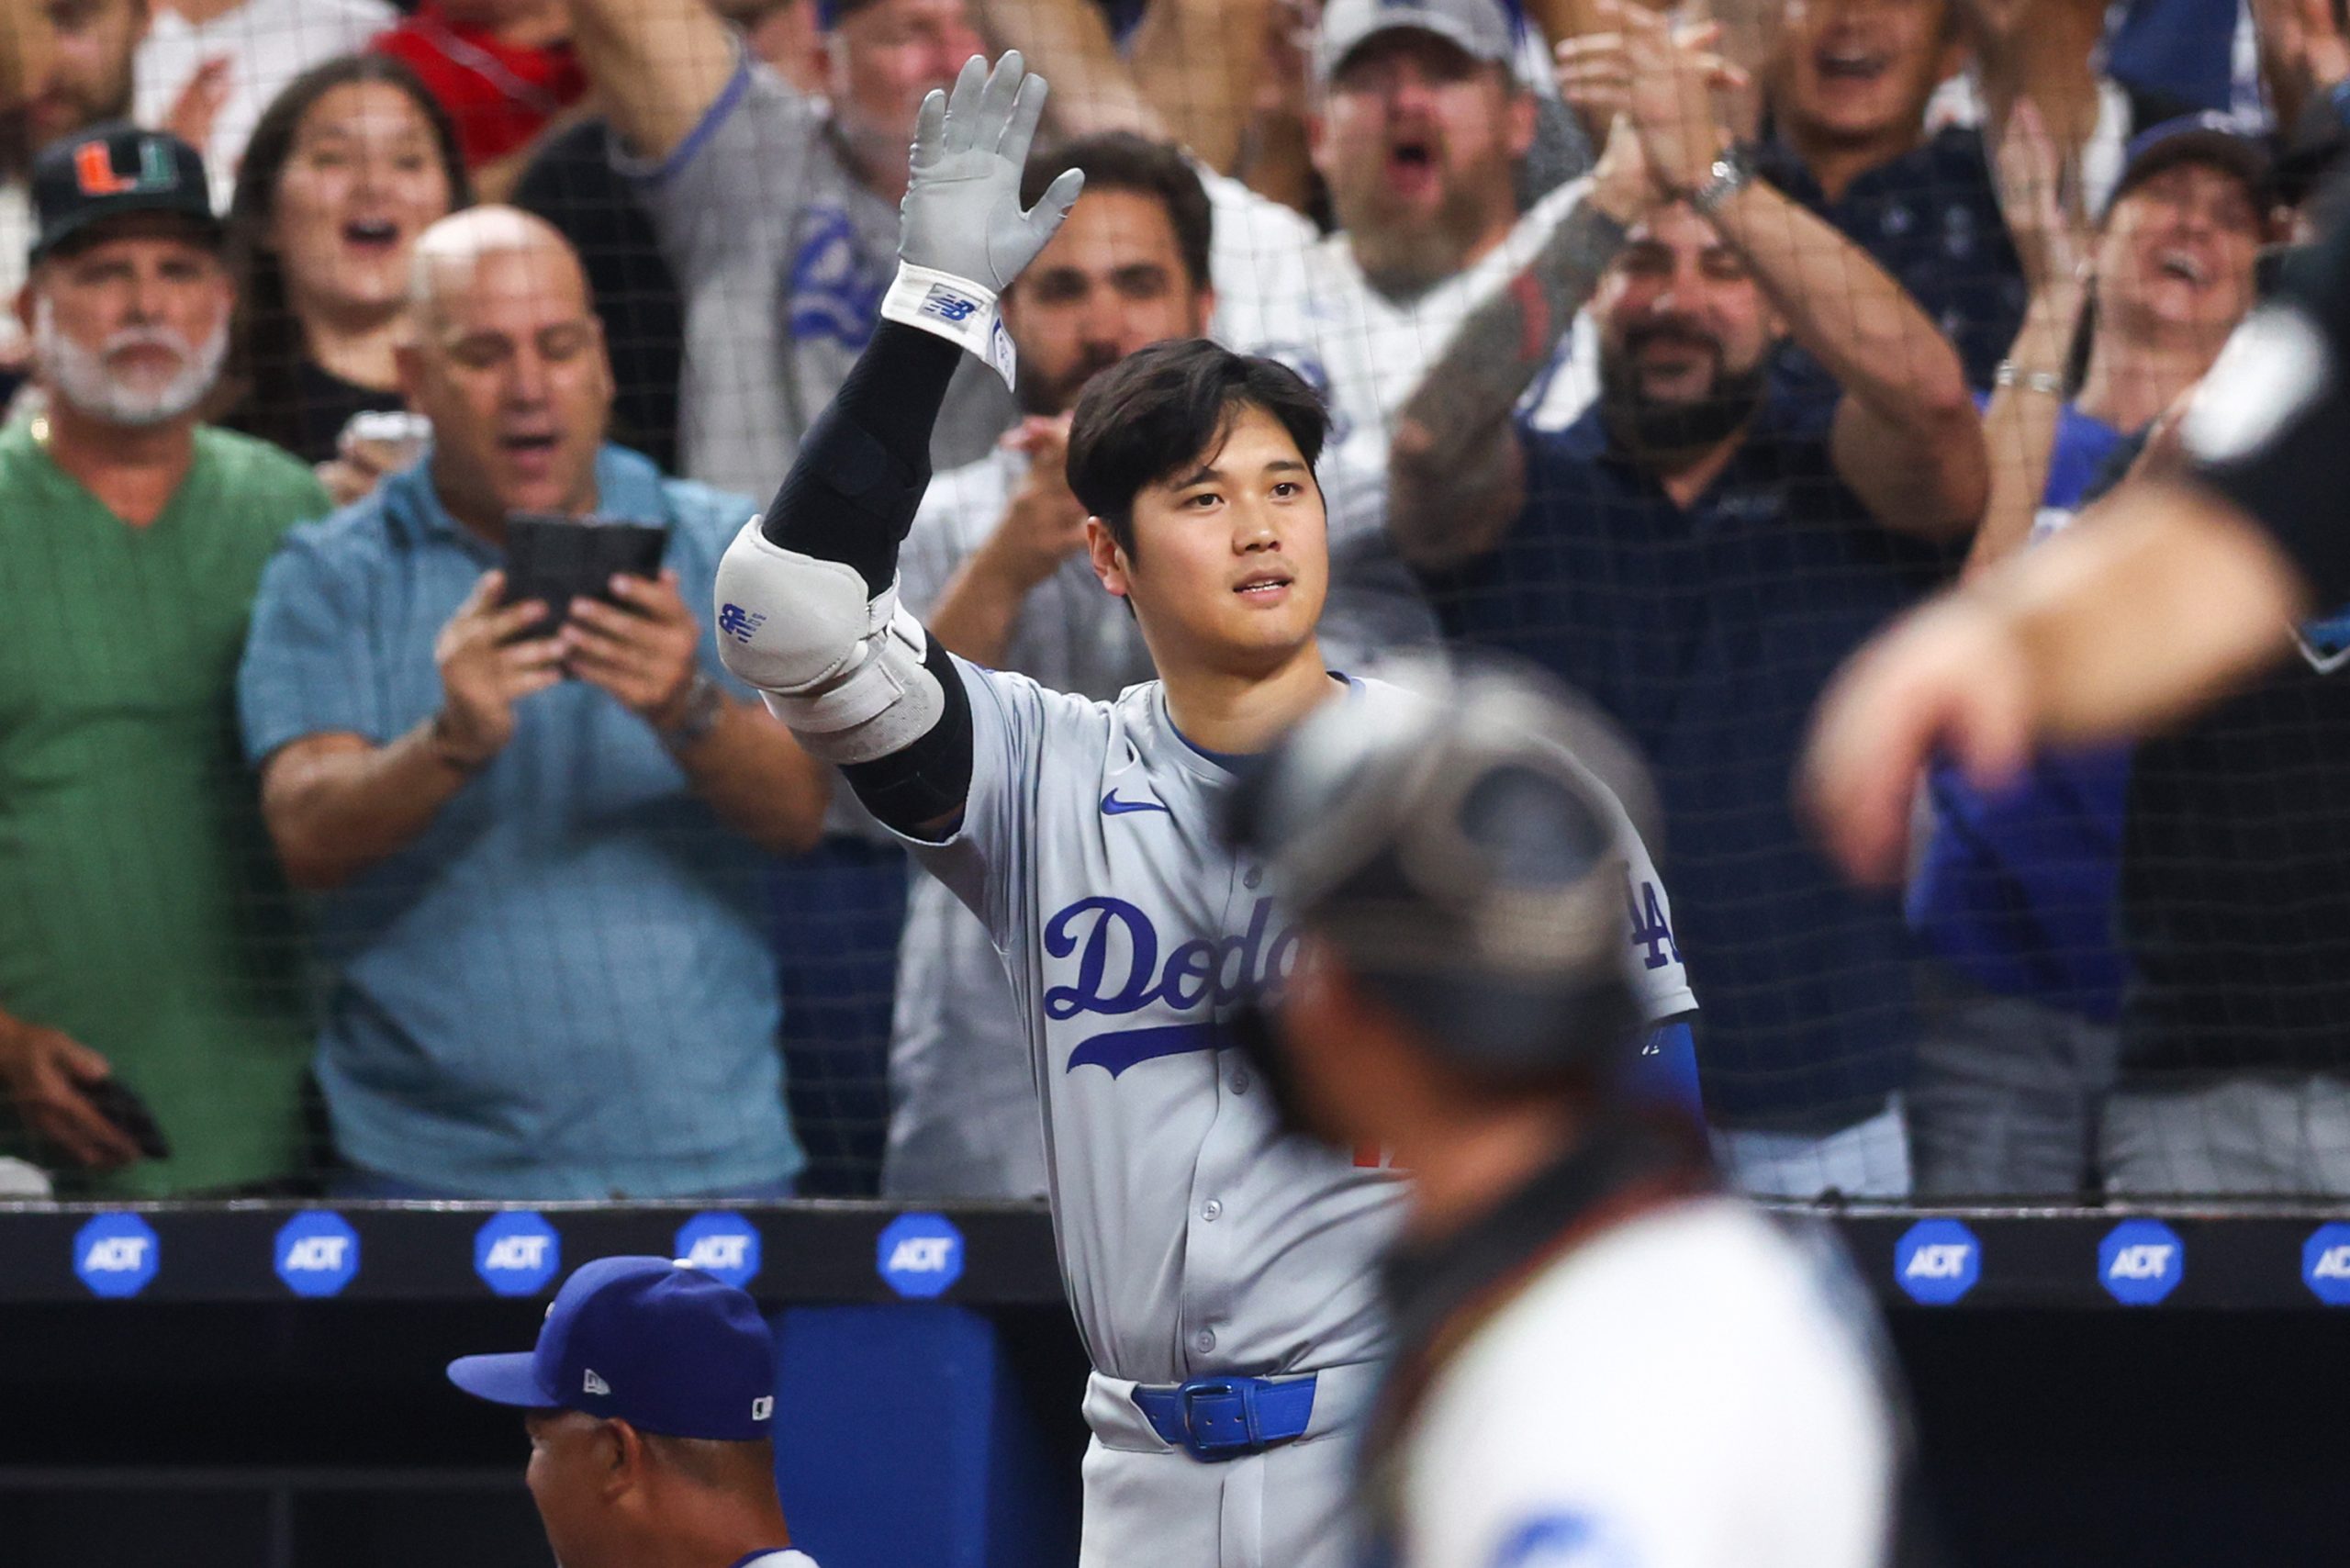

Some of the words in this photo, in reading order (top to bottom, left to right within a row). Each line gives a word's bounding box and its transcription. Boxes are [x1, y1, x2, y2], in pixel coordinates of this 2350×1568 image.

[73, 139, 180, 196] U
[84, 1237, 148, 1271] ADT
[286, 1236, 350, 1271] ADT
[485, 1235, 548, 1270] ADT
[688, 1236, 749, 1269] ADT
[888, 1237, 954, 1271] ADT
[1905, 1244, 1971, 1278] ADT
[2109, 1244, 2174, 1279] ADT
[2313, 1245, 2350, 1279] AD
